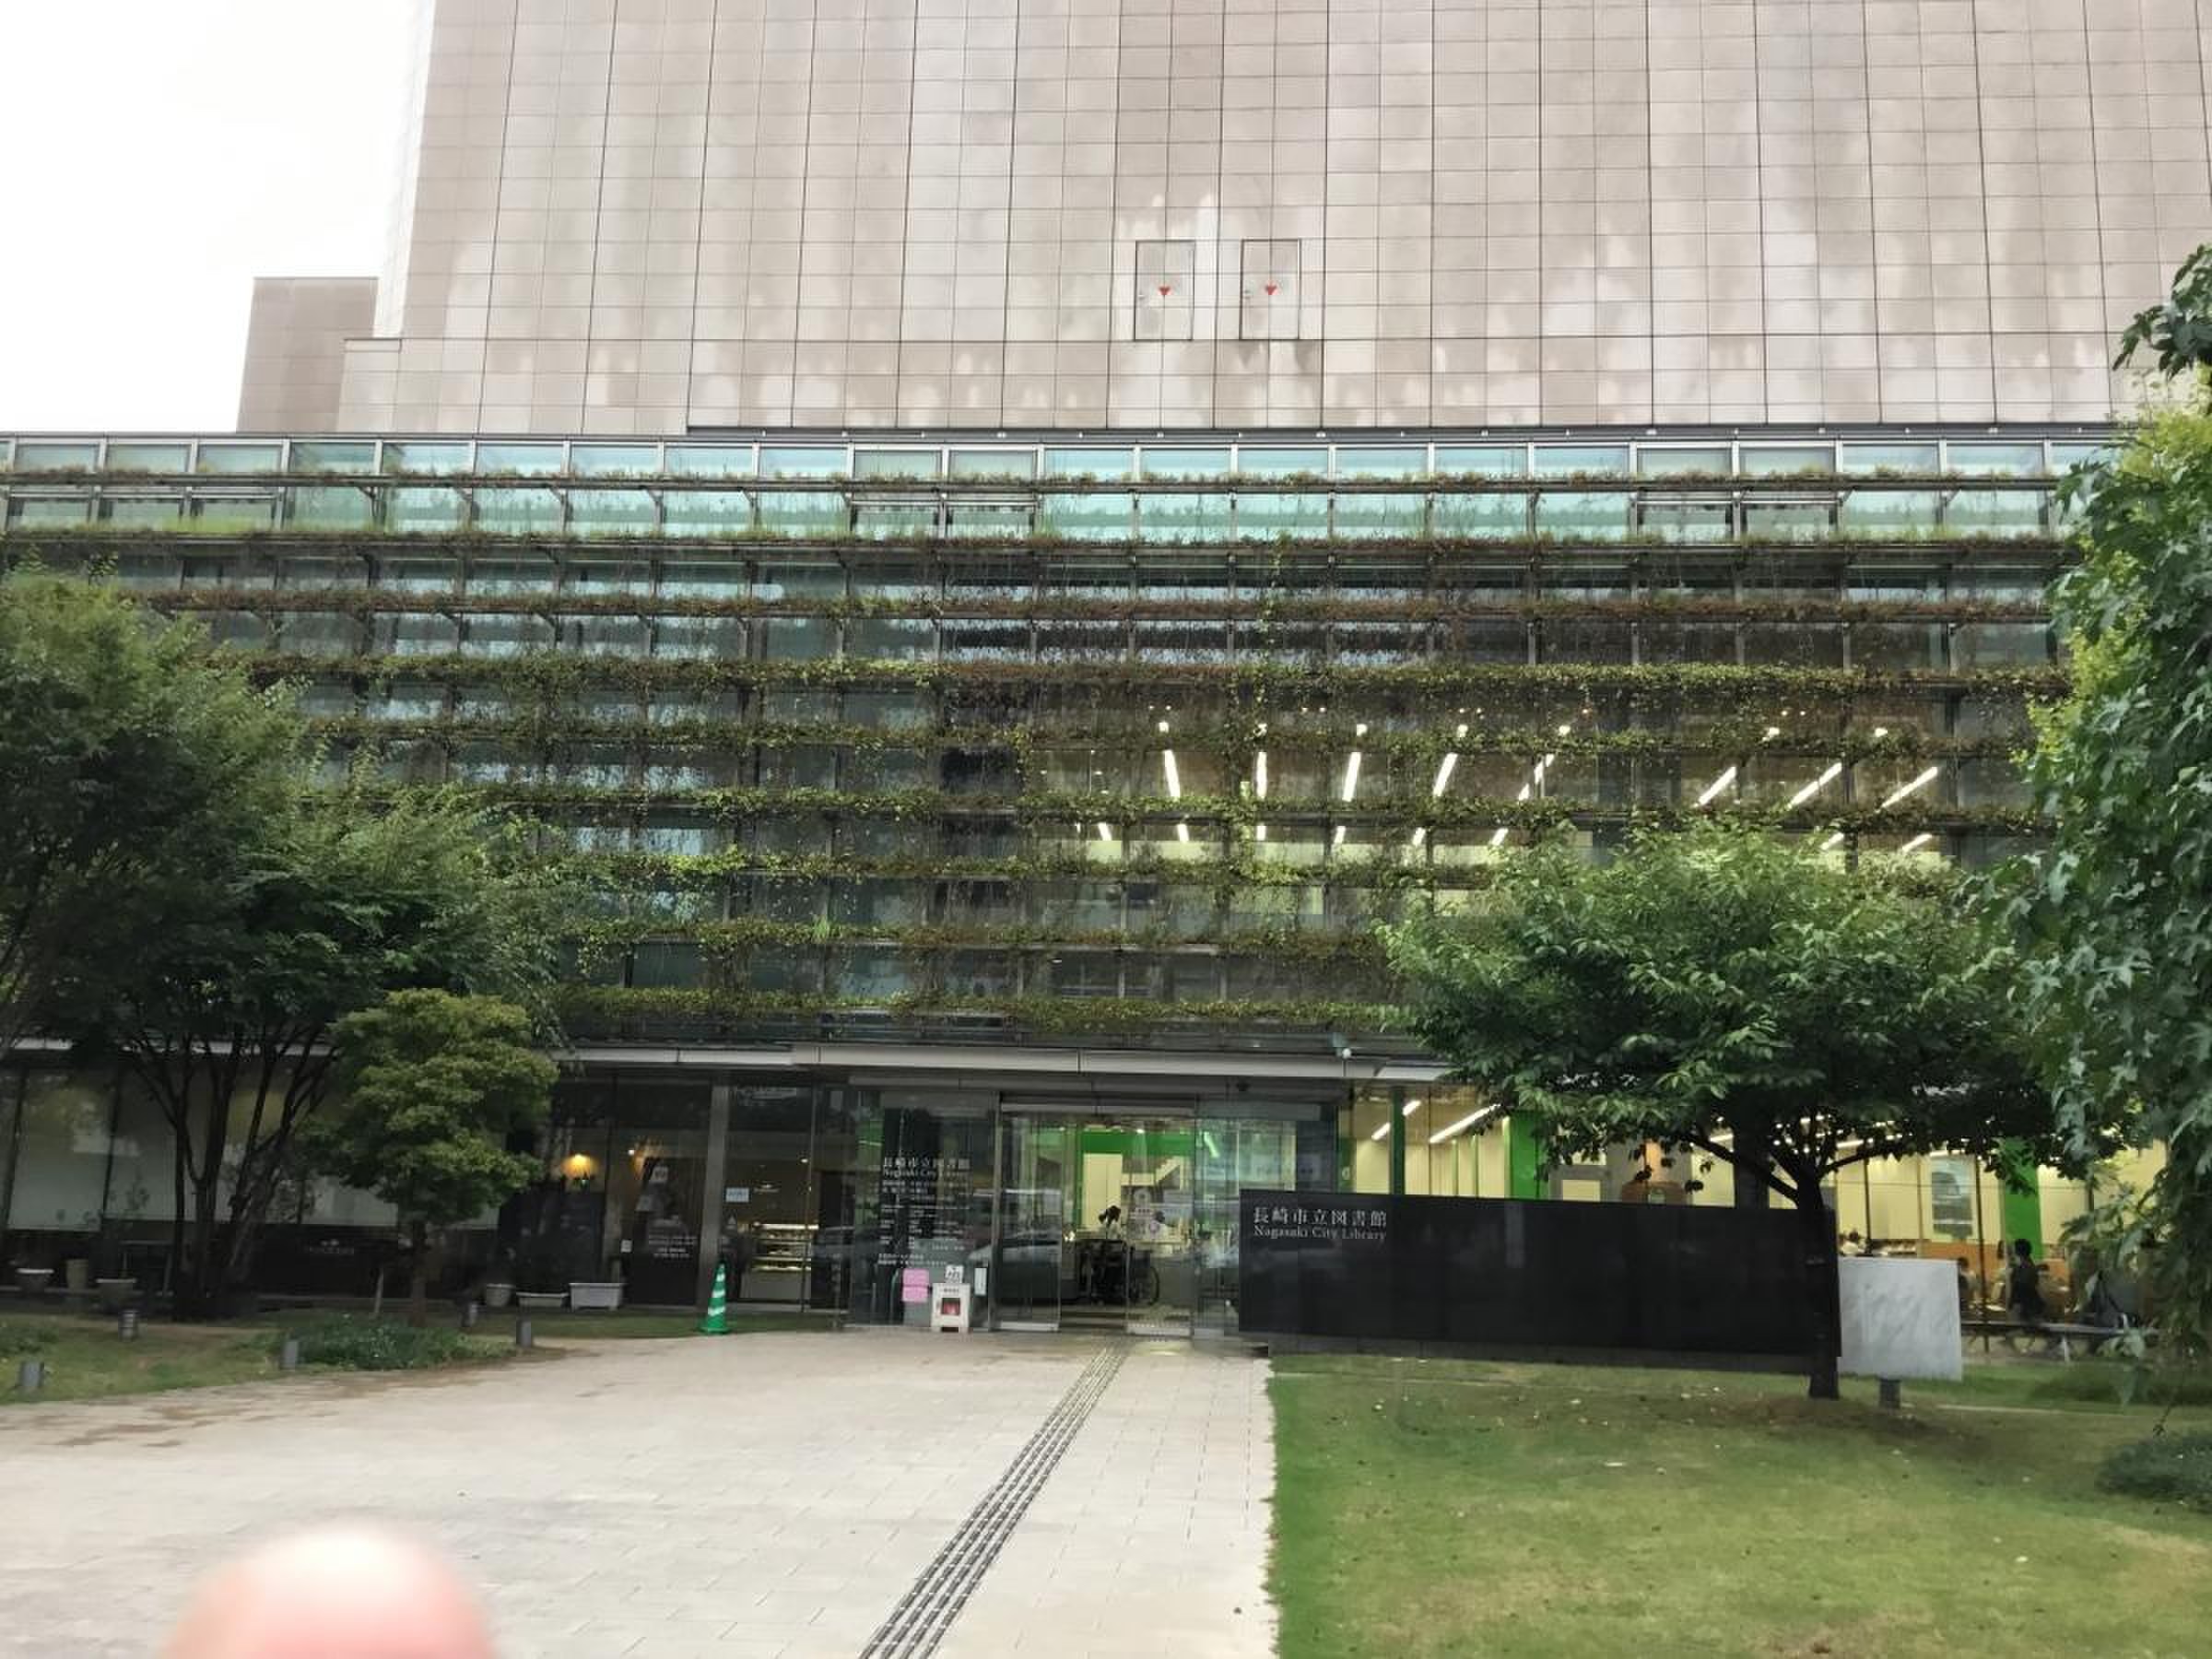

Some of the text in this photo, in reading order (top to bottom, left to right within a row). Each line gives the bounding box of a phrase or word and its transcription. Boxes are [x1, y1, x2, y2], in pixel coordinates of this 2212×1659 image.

[1253, 1206, 1387, 1227] 長崎市立図書館
[1253, 1225, 1387, 1240] Nagasaki City Library
